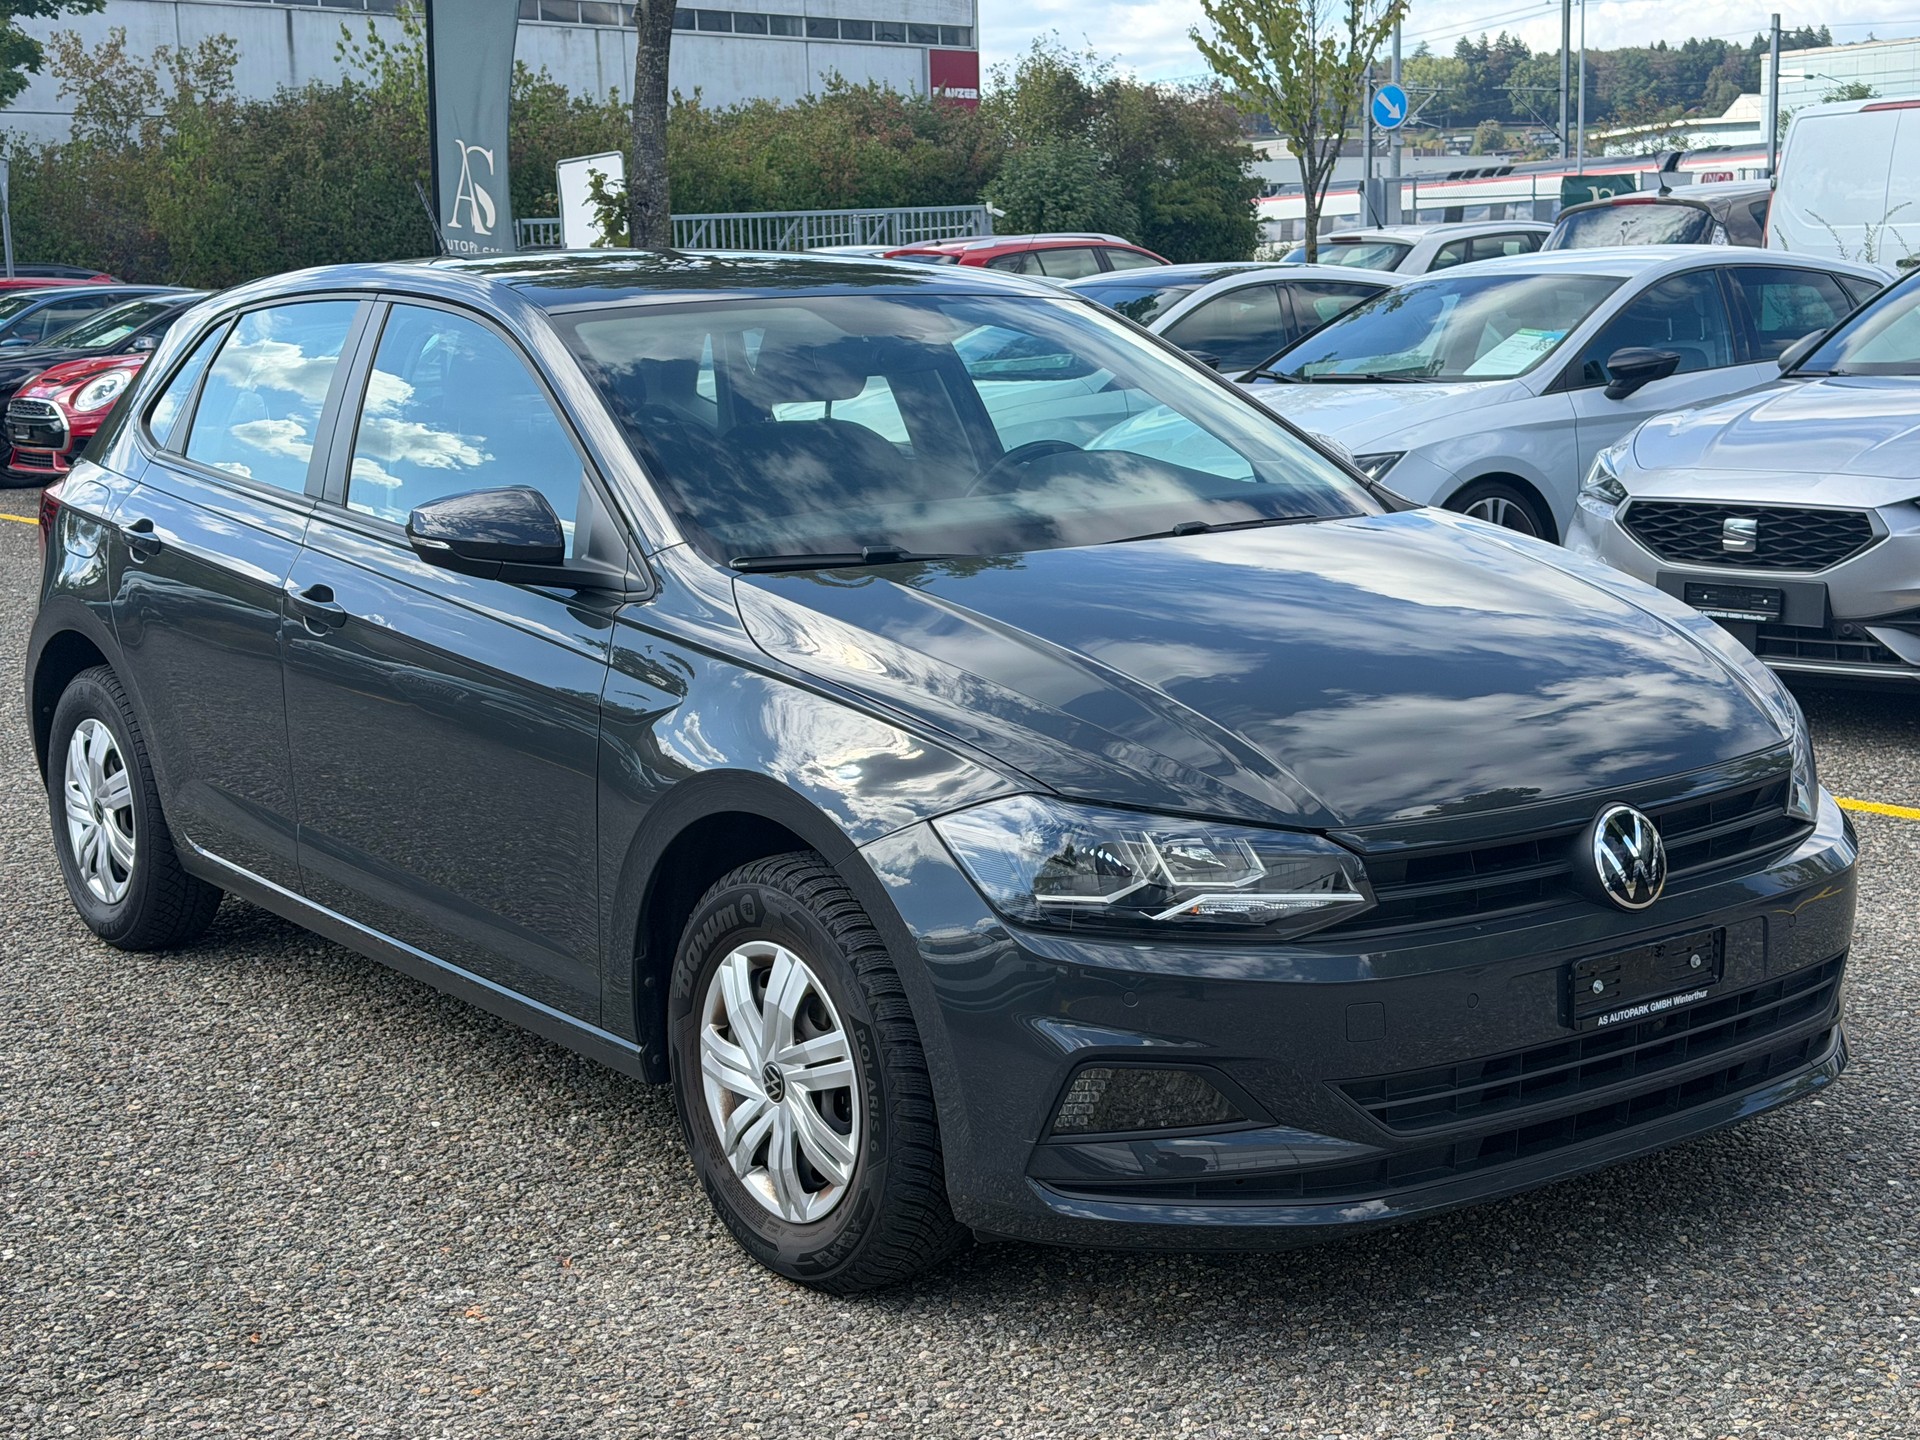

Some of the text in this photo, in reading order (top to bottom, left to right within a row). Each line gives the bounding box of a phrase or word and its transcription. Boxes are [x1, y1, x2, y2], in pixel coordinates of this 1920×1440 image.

[674, 903, 740, 998] Barum
[1597, 990, 1708, 1026] AS AUTOPARK GMBH Winterthur
[856, 1028, 880, 1152] POLARIS 6
